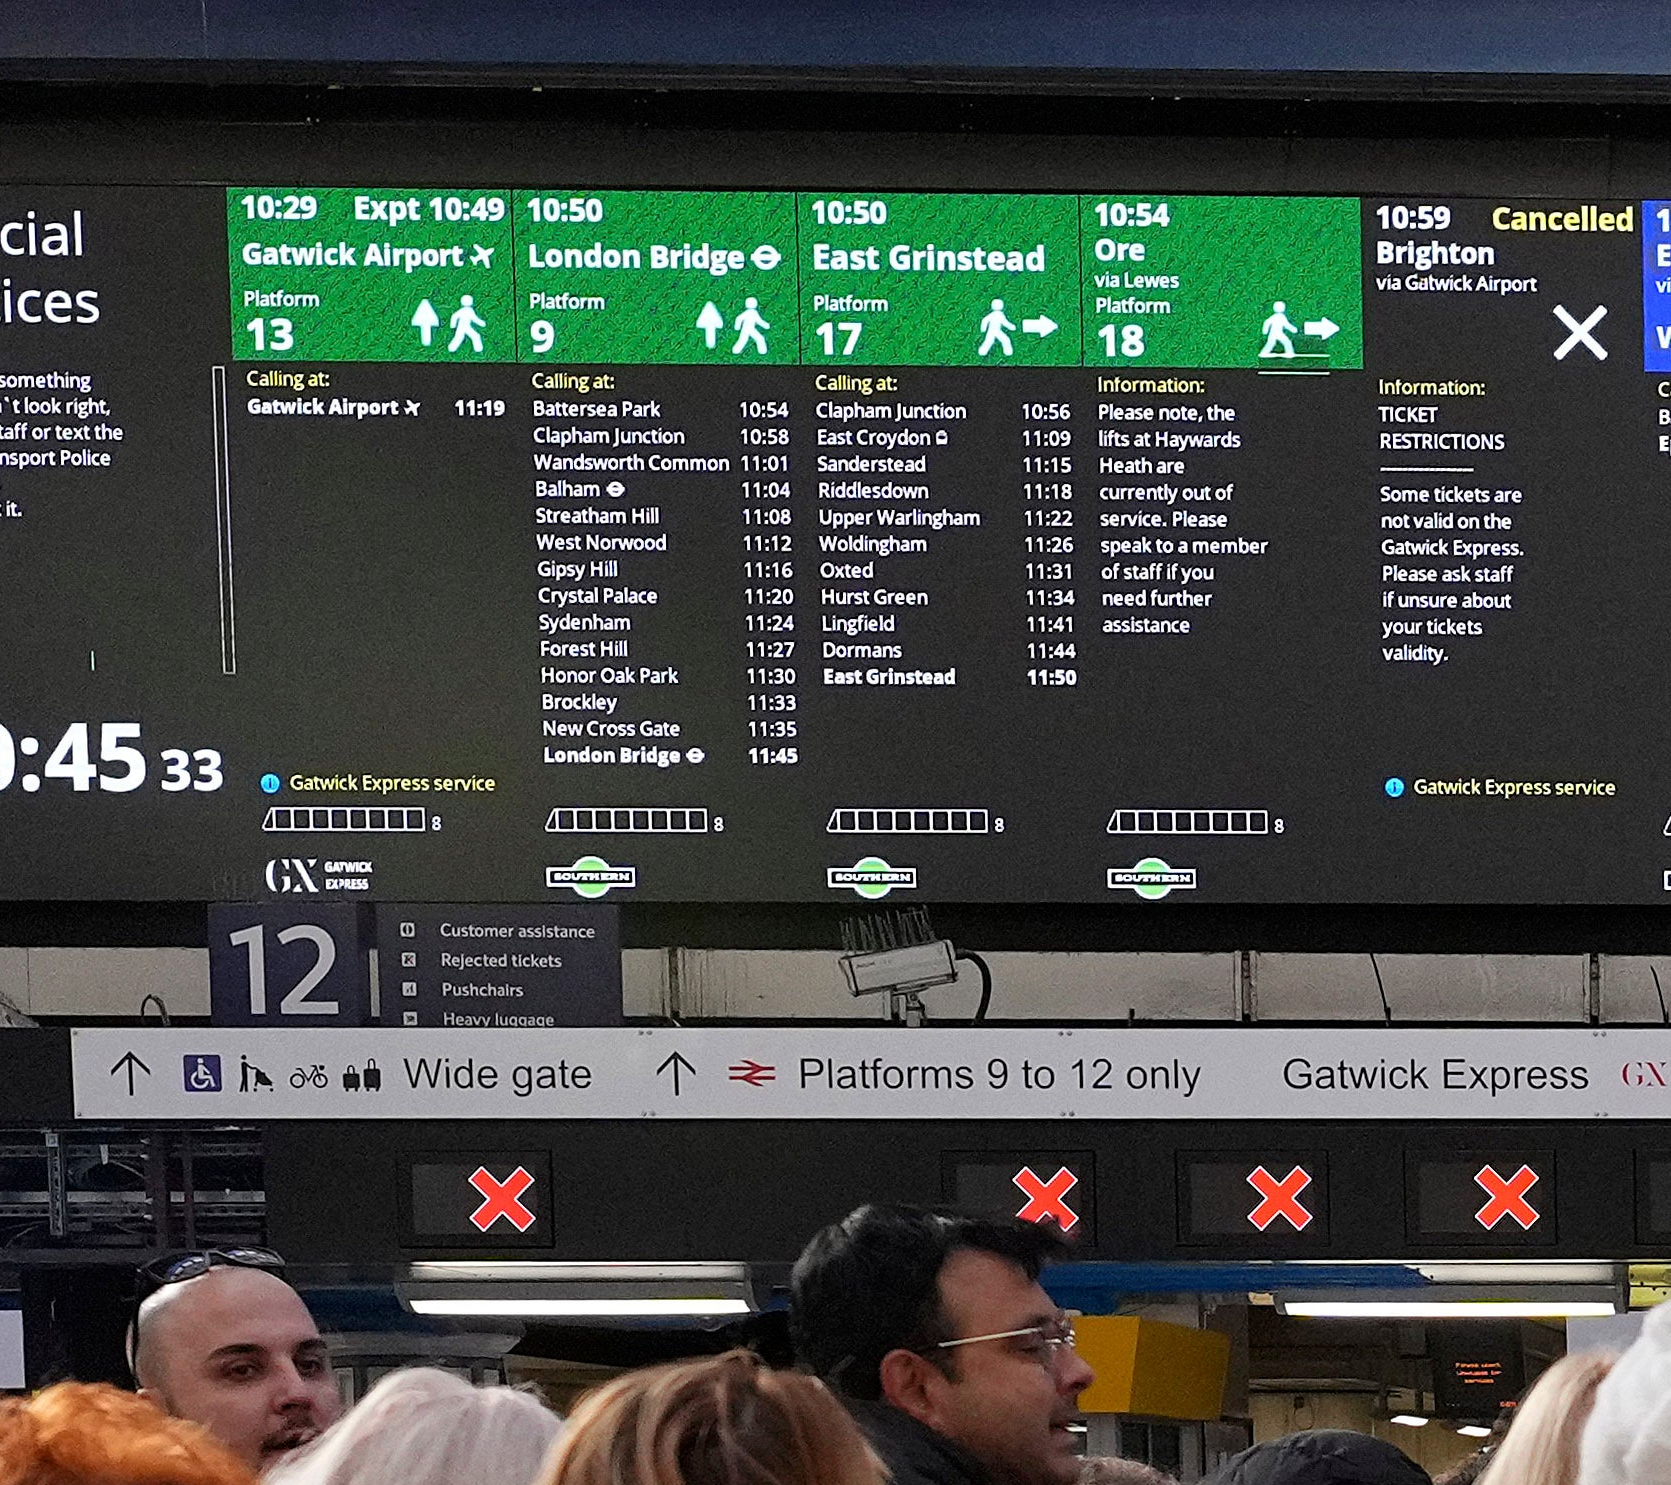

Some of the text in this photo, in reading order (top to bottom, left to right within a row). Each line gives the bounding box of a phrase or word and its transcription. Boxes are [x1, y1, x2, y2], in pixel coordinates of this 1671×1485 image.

[241, 194, 505, 228] 10:29 Expt 10:49
[527, 197, 603, 223] 10:50
[811, 200, 887, 225] 10:50
[1094, 202, 1171, 228] 10:54
[1376, 205, 1451, 230] 10:59
[1492, 205, 1634, 232] Cancelled
[242, 241, 464, 274] Gatwick Airport
[529, 241, 745, 277] London Bridge
[813, 243, 1045, 272] East Grinstead
[1094, 238, 1146, 262] Ore
[1377, 240, 1495, 271] Brighton
[1093, 271, 1180, 289] via Lewes
[1375, 273, 1402, 291] via
[1475, 275, 1538, 296] Airport
[243, 289, 320, 308] Platform
[529, 291, 605, 310] Platform
[813, 294, 889, 312] Platform
[1095, 296, 1171, 314] Platform
[246, 317, 294, 351] 13
[530, 319, 555, 353] 9
[816, 321, 863, 356] 17
[1098, 323, 1145, 357] 18
[160, 748, 223, 792] 33
[439, 922, 596, 939] Customer assistance
[229, 924, 339, 1015] 12
[403, 1057, 592, 1098] Wide gate
[800, 1057, 1201, 1098] Platforms 9 to 12 only
[1283, 1057, 1589, 1098] Gatwick Express
[1622, 1061, 1666, 1087] GX
